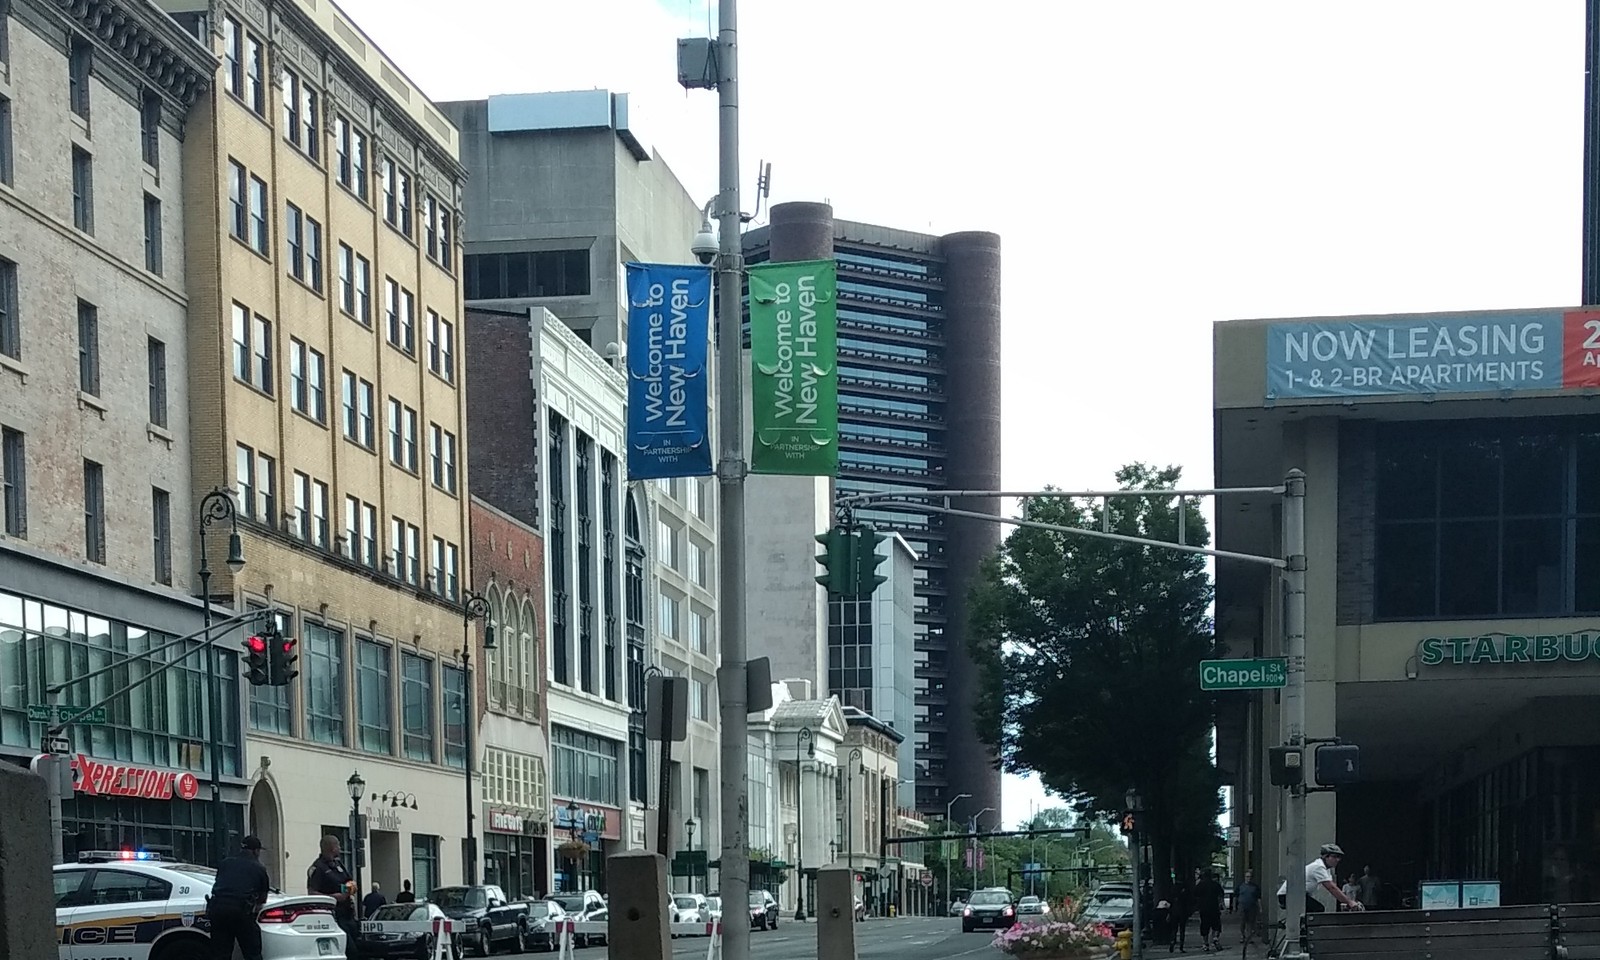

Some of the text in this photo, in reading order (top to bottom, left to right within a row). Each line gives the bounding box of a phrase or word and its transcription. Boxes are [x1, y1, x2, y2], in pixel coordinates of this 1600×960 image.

[644, 283, 664, 423] Welcome to
[665, 279, 689, 426] New Haven
[774, 283, 793, 418] Welcome to
[795, 276, 818, 424] New Haven
[1286, 323, 1544, 362] NOW LEASING
[1286, 360, 1544, 388] 1- & 2-BR APARTMENTS
[643, 446, 692, 455] PARTNERSHIP
[770, 443, 820, 451] PARTNERSHIP
[658, 455, 679, 463] WITH
[1421, 634, 1600, 665] STARBU
[1203, 663, 1281, 686] Chapel St
[1266, 674, 1278, 683] 900
[60, 710, 95, 722] Chpel
[178, 886, 190, 894] 30
[58, 925, 137, 945] ICE
[363, 922, 384, 932] HPD
